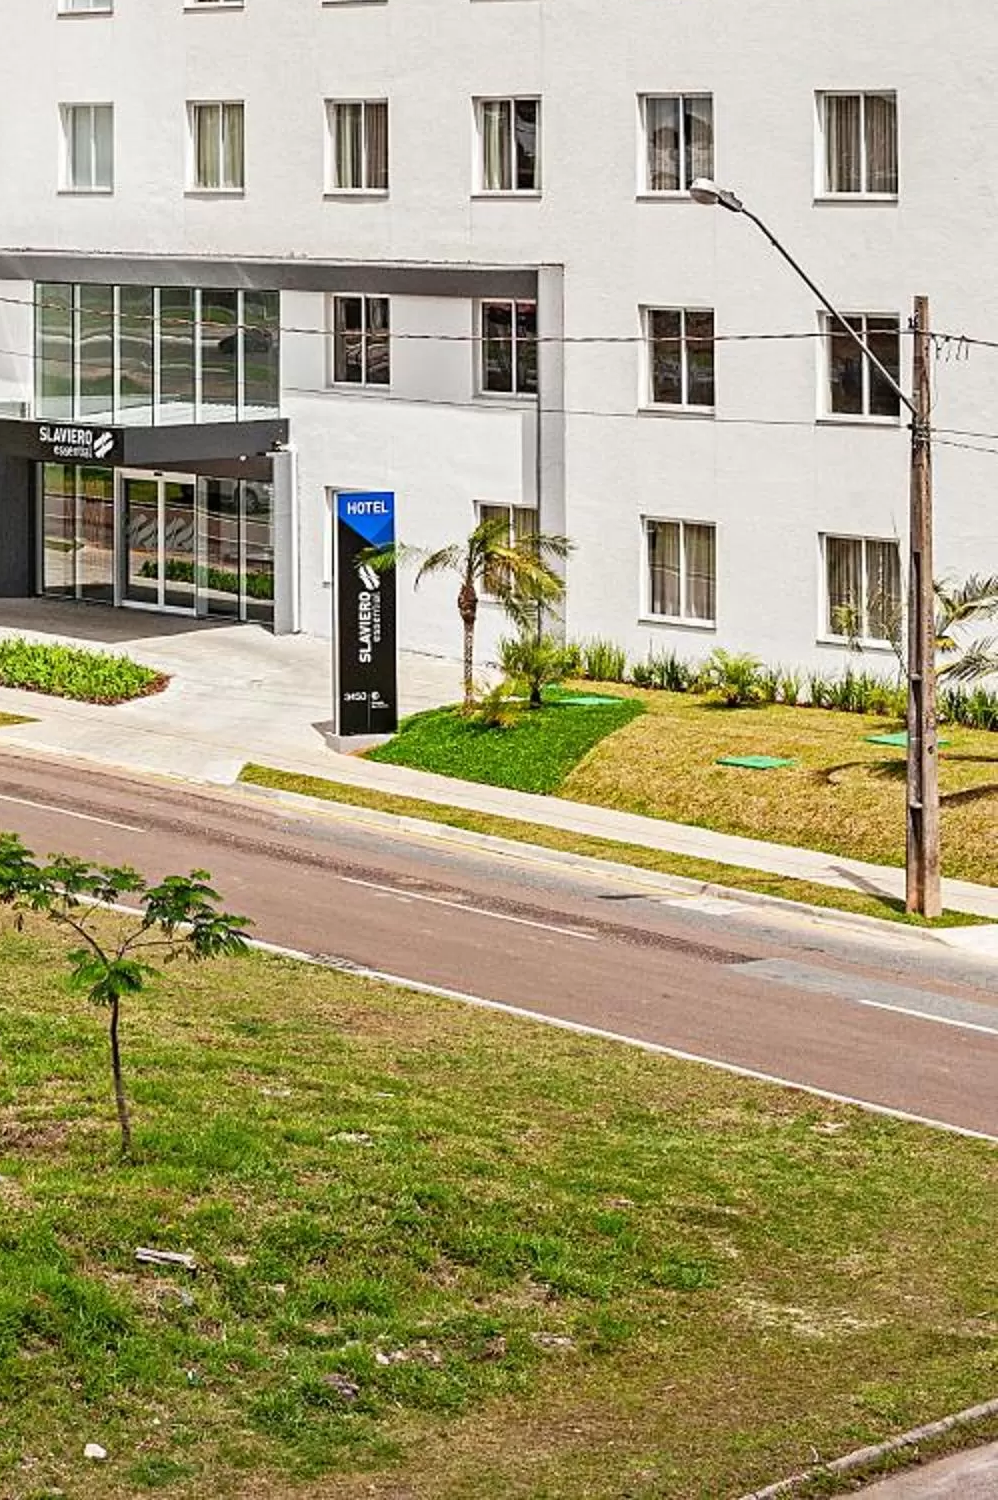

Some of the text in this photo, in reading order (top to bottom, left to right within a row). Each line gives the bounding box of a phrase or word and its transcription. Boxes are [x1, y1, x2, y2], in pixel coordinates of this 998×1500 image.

[39, 425, 93, 446] SLAVIERO
[347, 501, 389, 515] HOTEL
[359, 591, 372, 663] SLAVIERO
